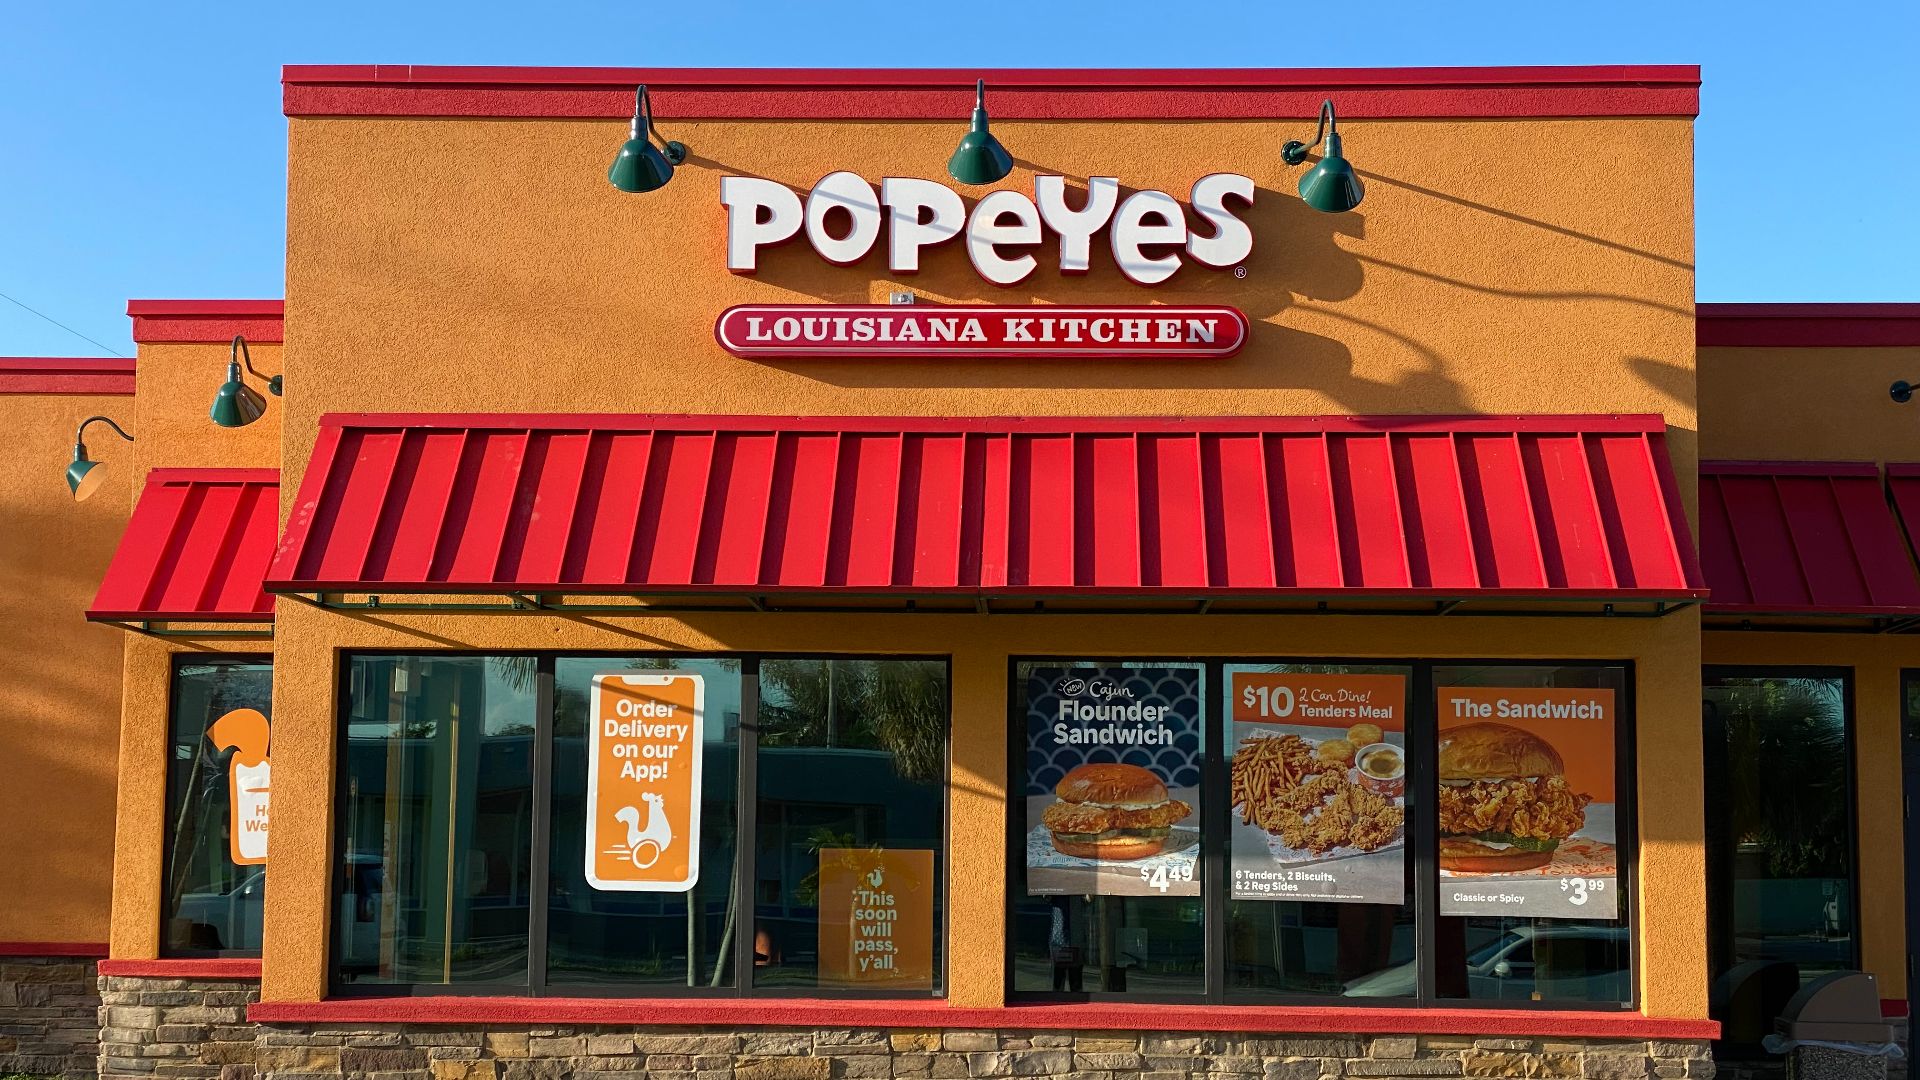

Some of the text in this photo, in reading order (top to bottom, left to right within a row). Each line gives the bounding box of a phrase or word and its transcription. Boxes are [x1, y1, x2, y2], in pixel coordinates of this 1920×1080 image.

[745, 316, 1218, 343] LOUISIANA KITCHEN
[1089, 681, 1134, 701] Cajun
[1299, 687, 1372, 704] 2 Can Dine!
[615, 699, 678, 718] Order
[1243, 685, 1294, 718] $10
[1450, 698, 1603, 720] The Sandwich
[1059, 700, 1170, 721] Flounder
[1298, 704, 1393, 719] Tenders Meal
[604, 719, 688, 742] Delivery
[1053, 722, 1173, 745] Sandwich
[612, 743, 679, 759] on our
[620, 761, 668, 782] App!
[1235, 870, 1336, 882] 6 Tenders, 2 Biscuits,
[1235, 881, 1298, 892] & 2 Reg Sides
[858, 891, 895, 906] This
[1453, 892, 1525, 905] Classic or Spicy
[855, 909, 897, 921] soon
[861, 922, 892, 937] will
[854, 940, 899, 954] pass,
